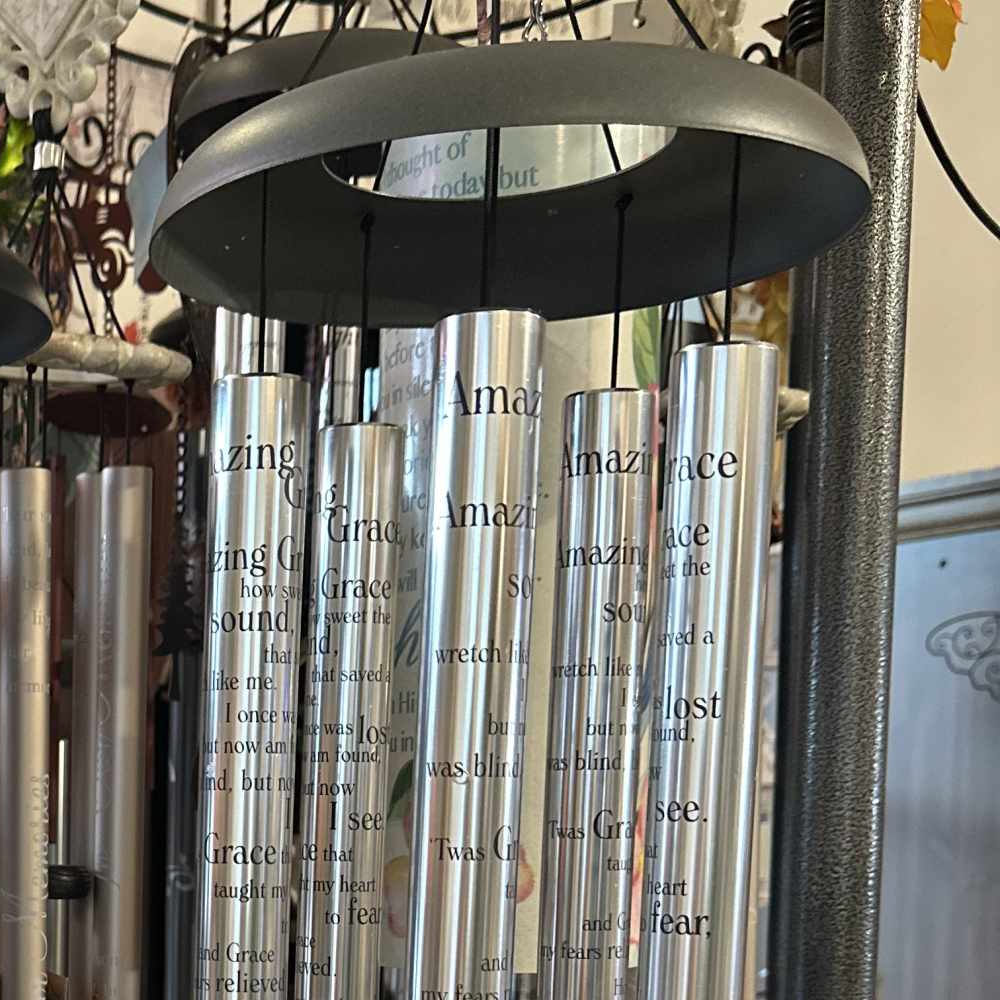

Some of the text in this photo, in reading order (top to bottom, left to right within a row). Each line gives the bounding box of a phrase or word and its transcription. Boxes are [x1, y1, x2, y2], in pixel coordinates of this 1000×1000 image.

[449, 132, 471, 160] of
[500, 167, 539, 189] but
[682, 555, 711, 577] the
[241, 578, 277, 597] how
[321, 568, 391, 599] Grace
[325, 606, 391, 624] sweet the
[703, 634, 714, 645] a
[436, 644, 500, 663] wretch
[340, 664, 383, 682] saved
[606, 657, 633, 676] like
[664, 687, 721, 721] lost
[238, 707, 277, 723] once
[325, 722, 352, 734] was
[586, 717, 613, 737] but
[224, 740, 287, 753] now am
[427, 761, 463, 777] was
[242, 770, 272, 791] but
[320, 780, 355, 795] now
[655, 799, 708, 823] see.
[204, 833, 276, 864] Grace
[214, 880, 265, 902] taught
[313, 875, 376, 895] my heart
[325, 911, 341, 925] to
[582, 917, 611, 931] and
[651, 901, 711, 940] fear,
[227, 943, 275, 962] Grace
[561, 944, 600, 961] fears
